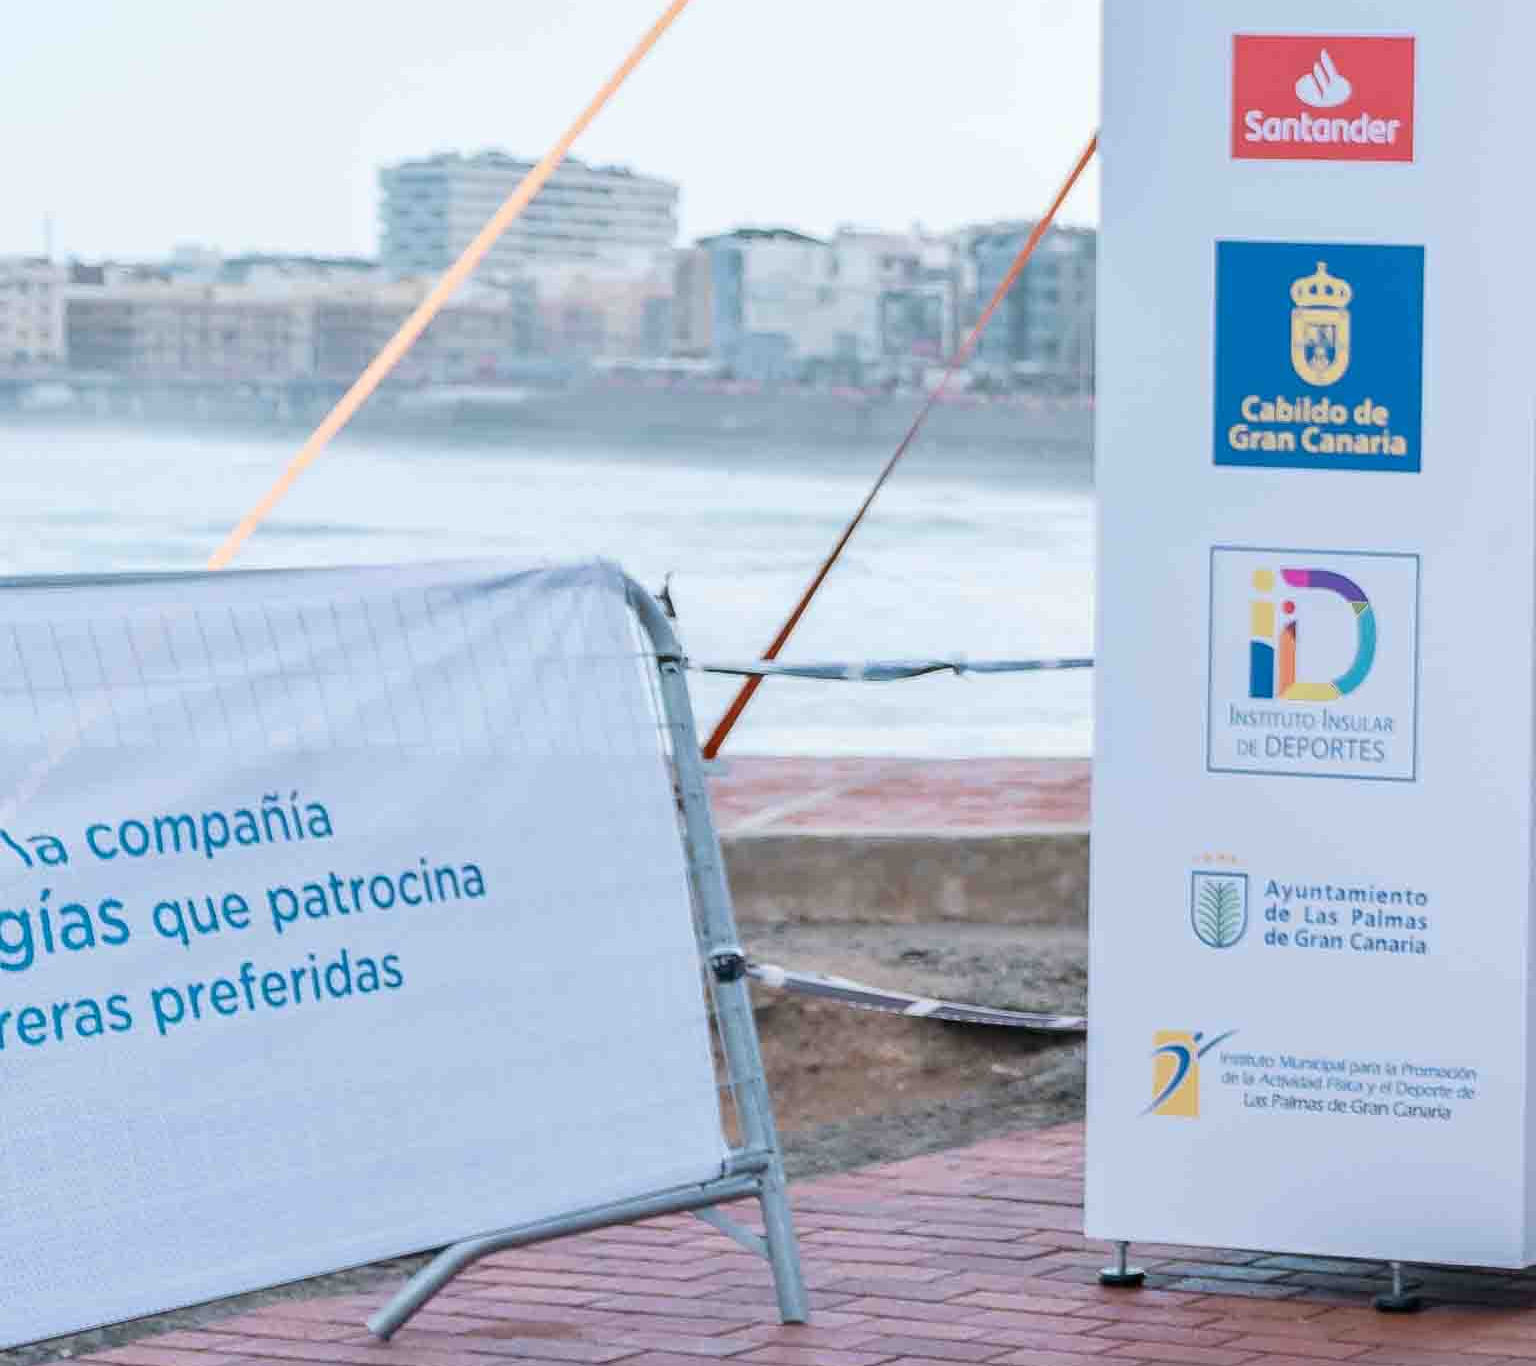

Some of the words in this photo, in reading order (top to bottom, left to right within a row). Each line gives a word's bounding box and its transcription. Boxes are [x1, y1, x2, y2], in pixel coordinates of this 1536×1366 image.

[1244, 110, 1401, 146] Santander
[1240, 395, 1346, 426] Cabildo
[1351, 398, 1390, 428] de
[1228, 424, 1294, 453] Gran
[1301, 426, 1408, 458] Canaria
[1228, 705, 1316, 730] INSTITUTO
[1320, 706, 1395, 733] INSULAR
[1237, 738, 1258, 757] DE
[1264, 734, 1386, 763] DEPORTES
[85, 789, 334, 865] compañía
[152, 887, 250, 948] que
[267, 857, 487, 934] patrocina
[1264, 878, 1429, 908] Ayuntamiento
[1264, 904, 1292, 924] de
[1303, 905, 1339, 927] Las
[1350, 907, 1429, 932] Palmas
[1263, 927, 1290, 948] de
[1294, 929, 1344, 952] Gran
[1349, 930, 1428, 956] Canaria
[151, 948, 404, 1036] preferidas
[1219, 1050, 1277, 1068] Instituto
[1279, 1054, 1347, 1073] Municipal
[1350, 1061, 1382, 1077] para
[1386, 1059, 1397, 1075] la
[1402, 1061, 1478, 1082] Promoción
[1220, 1071, 1239, 1084] de
[1242, 1072, 1255, 1086] la
[1257, 1073, 1323, 1090] Actividad
[1379, 1079, 1392, 1092] el
[1396, 1080, 1454, 1099] Deporte
[1456, 1085, 1476, 1100] de
[1243, 1091, 1267, 1108] Las
[1271, 1092, 1324, 1113] Palmas
[1328, 1097, 1348, 1114] de
[1350, 1098, 1390, 1116] Gran
[1392, 1101, 1452, 1120] Canaria
